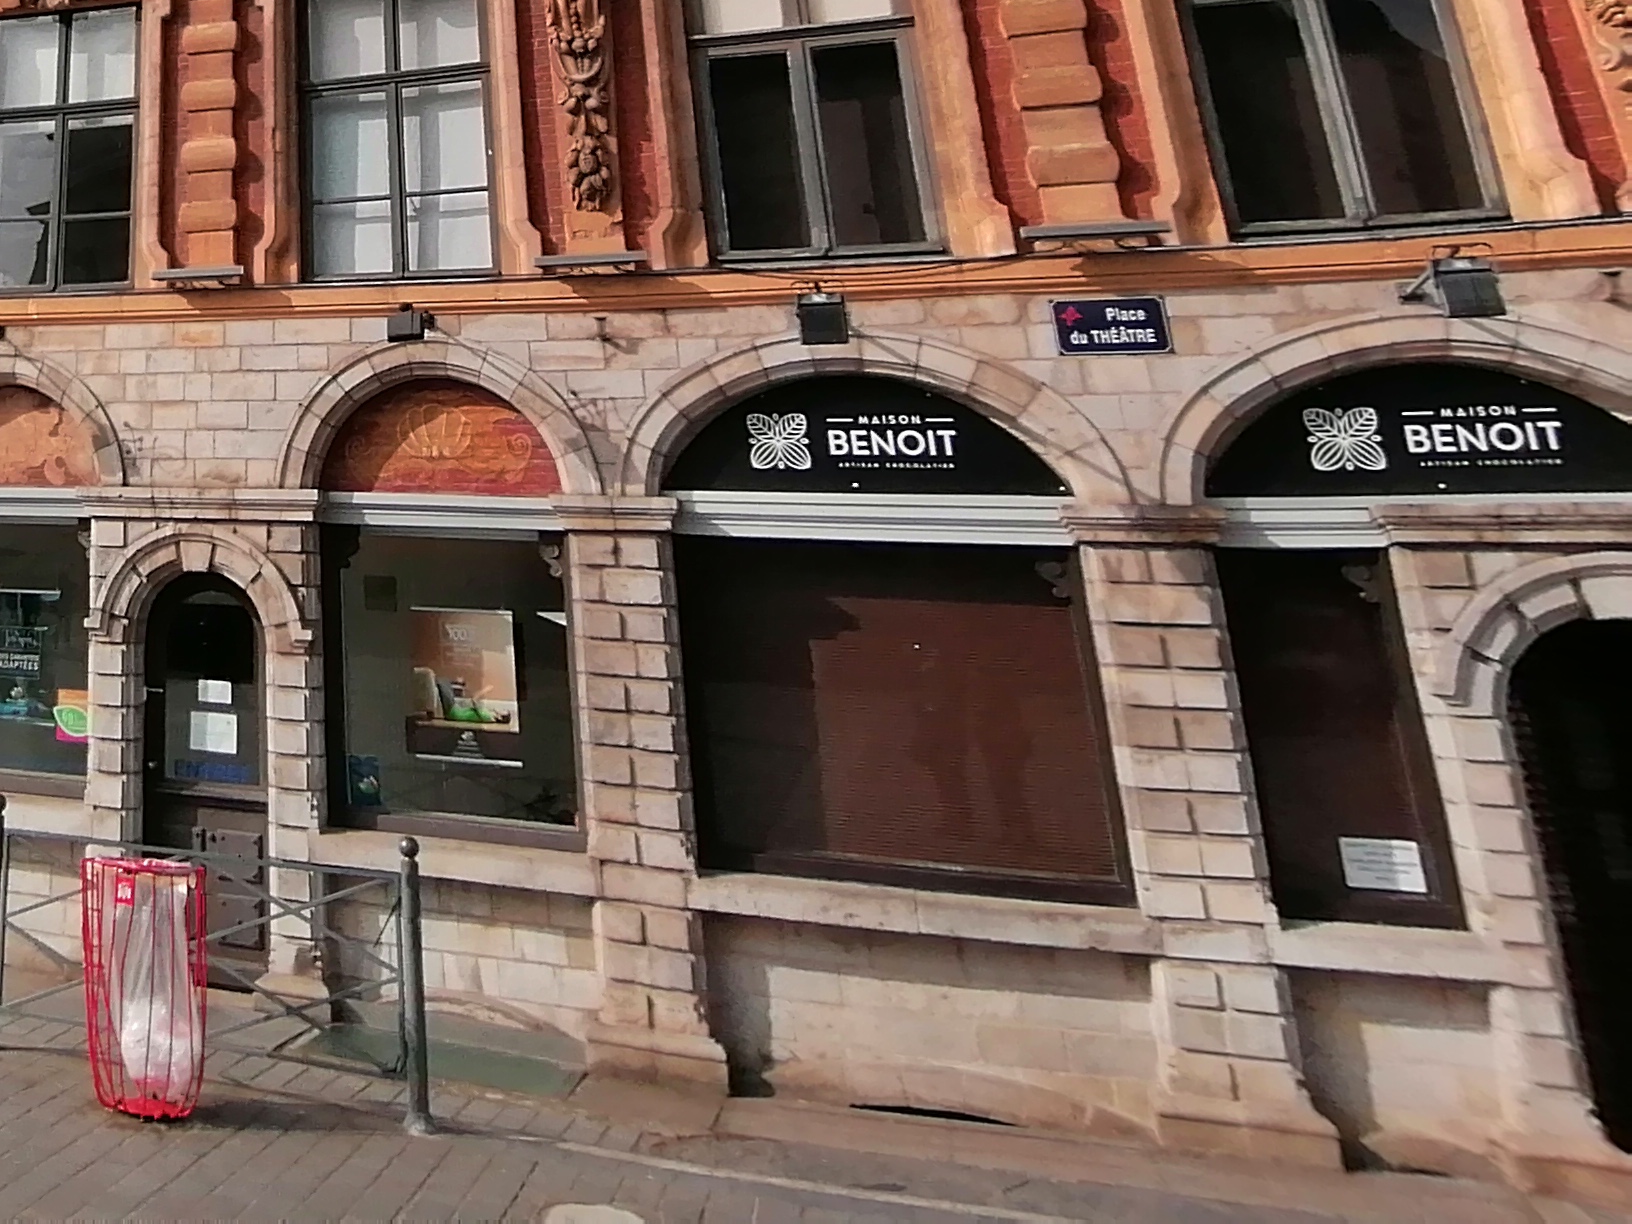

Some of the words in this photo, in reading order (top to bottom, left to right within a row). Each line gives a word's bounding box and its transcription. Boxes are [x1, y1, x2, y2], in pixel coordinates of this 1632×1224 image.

[1105, 307, 1147, 321] Place
[1070, 330, 1088, 345] du
[1090, 326, 1158, 344] THÉÂTRE
[858, 414, 922, 425] MAISON
[1440, 405, 1517, 418] MAISON
[827, 429, 957, 456] BENOIT
[1403, 421, 1563, 454] BENOIT
